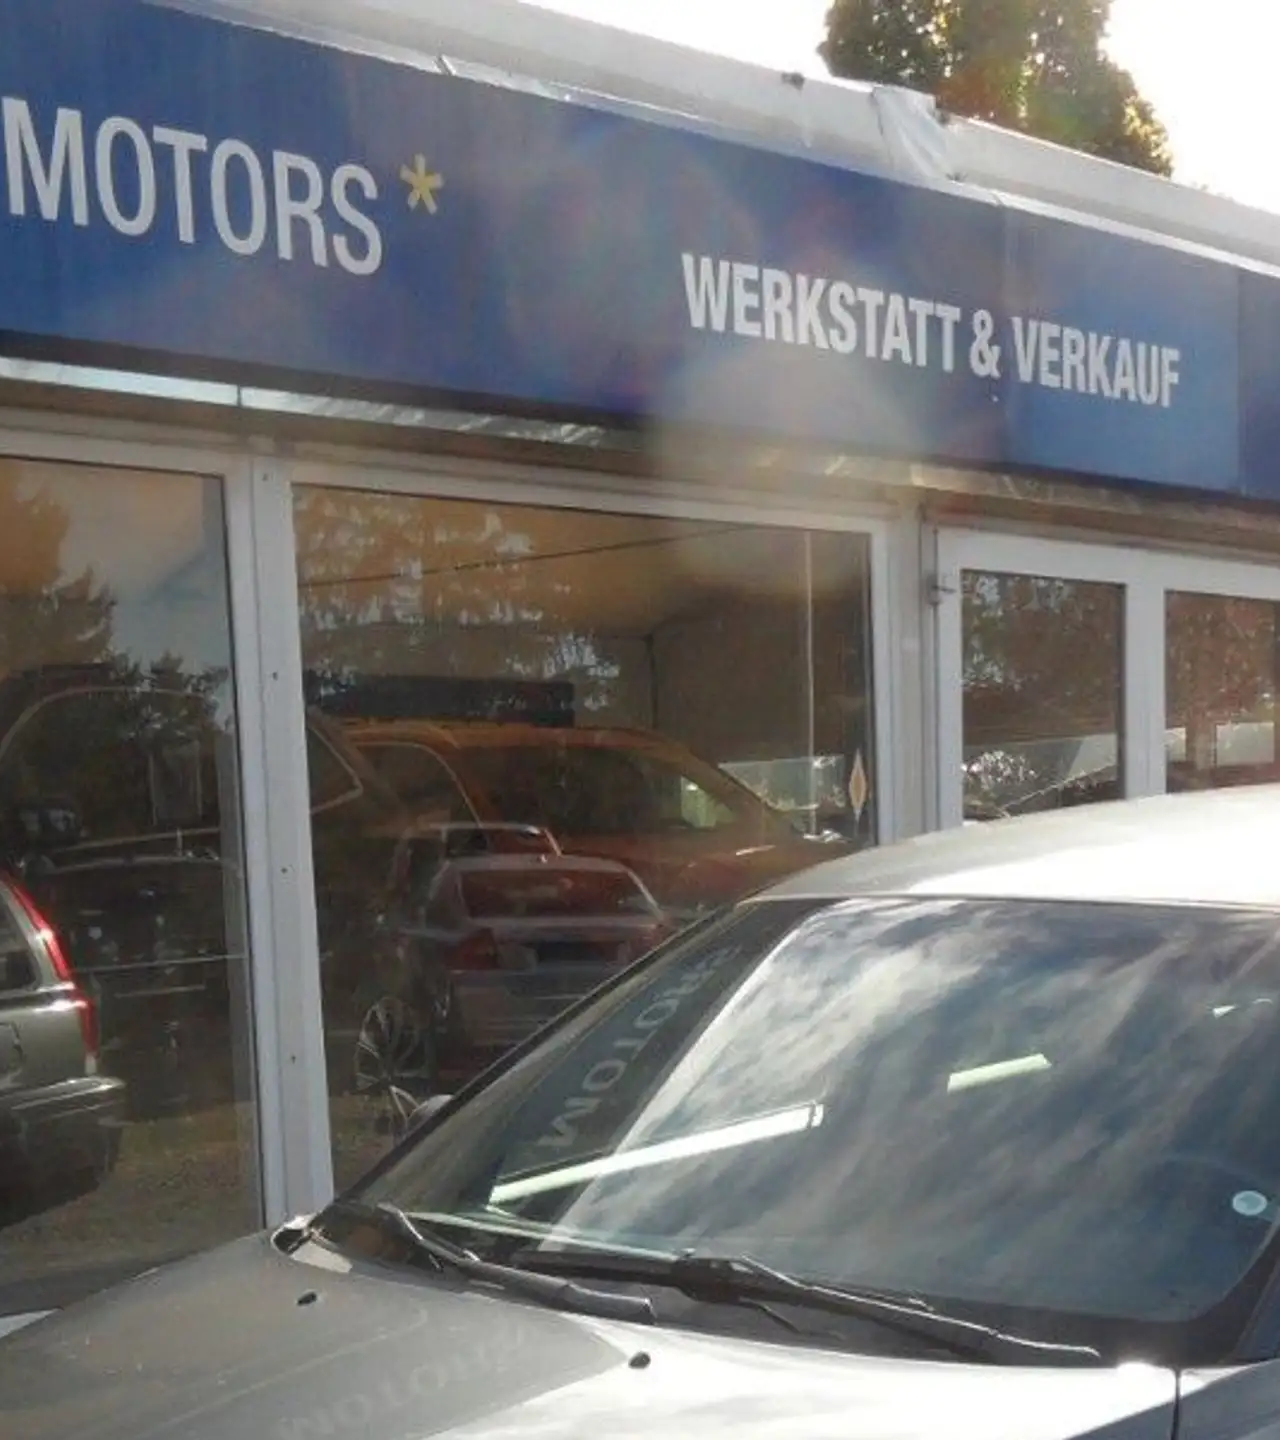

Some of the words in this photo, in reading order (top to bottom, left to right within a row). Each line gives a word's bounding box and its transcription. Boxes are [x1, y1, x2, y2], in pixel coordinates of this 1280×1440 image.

[681, 251, 961, 374] WERKSTATT
[968, 308, 1001, 379] &
[1011, 315, 1181, 408] VERKAUF
